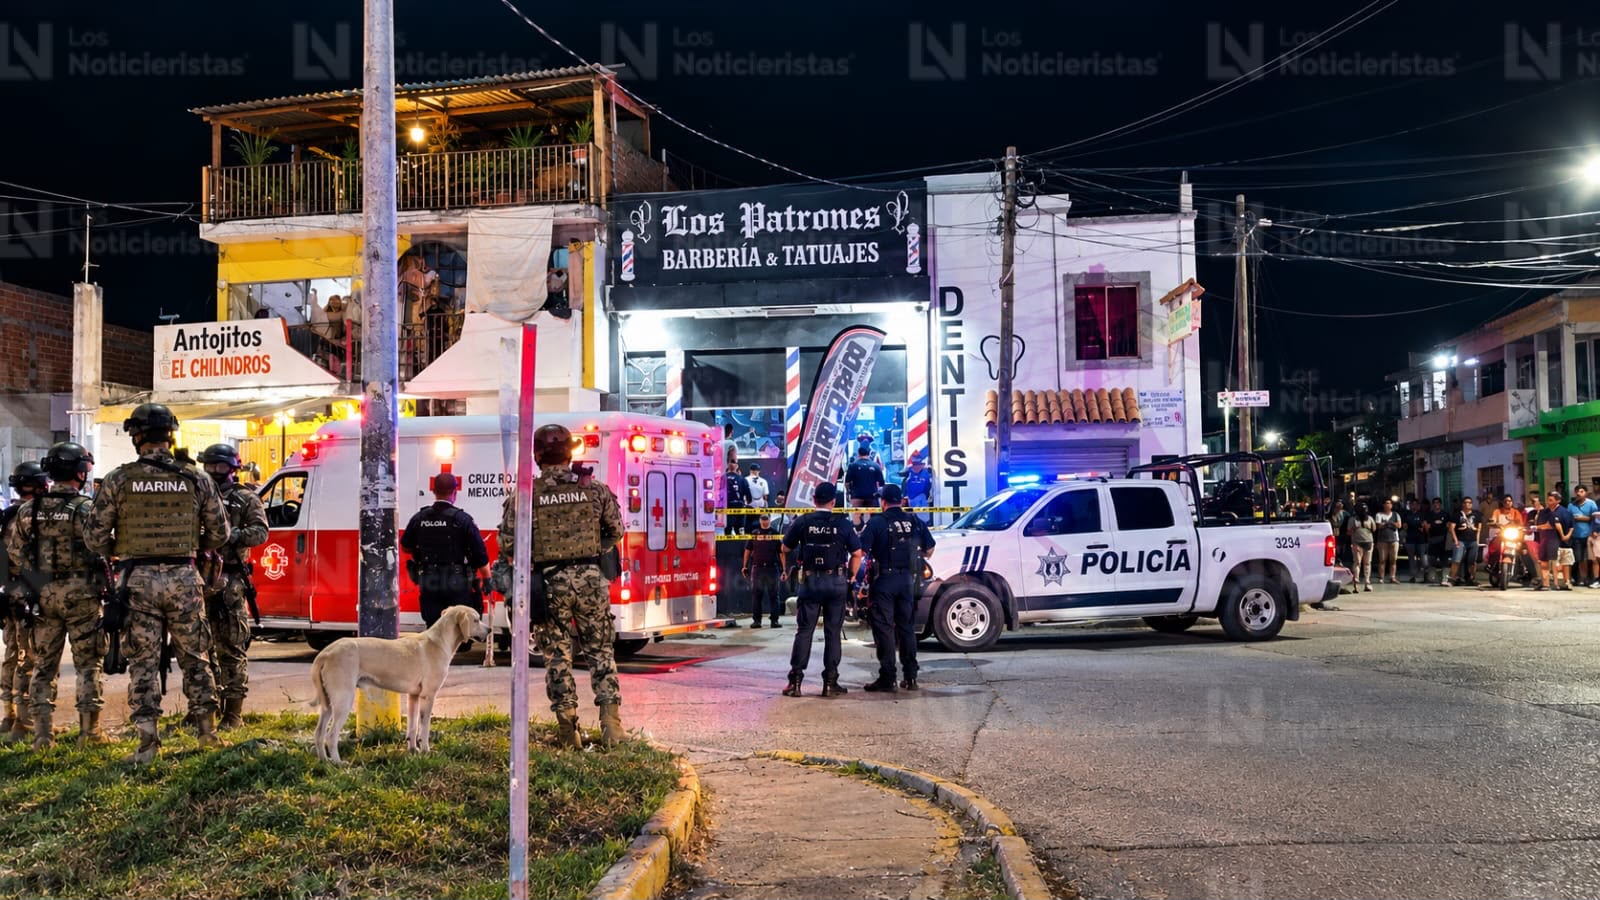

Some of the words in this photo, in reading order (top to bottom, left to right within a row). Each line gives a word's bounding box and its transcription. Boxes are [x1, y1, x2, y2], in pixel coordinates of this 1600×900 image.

[660, 204, 725, 237] Los
[739, 202, 881, 239] Patrones
[662, 243, 762, 270] BARBERÍA
[766, 252, 779, 267] &
[782, 242, 880, 266] TATUAJES
[173, 325, 262, 355] Antojitos
[171, 359, 186, 379] EL
[190, 354, 271, 378] CHILINDROS
[132, 481, 188, 493] MARINA
[468, 473, 496, 485] CRUZ
[498, 473, 517, 484] ROJ
[467, 487, 514, 498] MEXICAN
[539, 491, 588, 505] MARINA
[1275, 536, 1301, 549] 3234
[1080, 543, 1191, 575] POLICÍA
